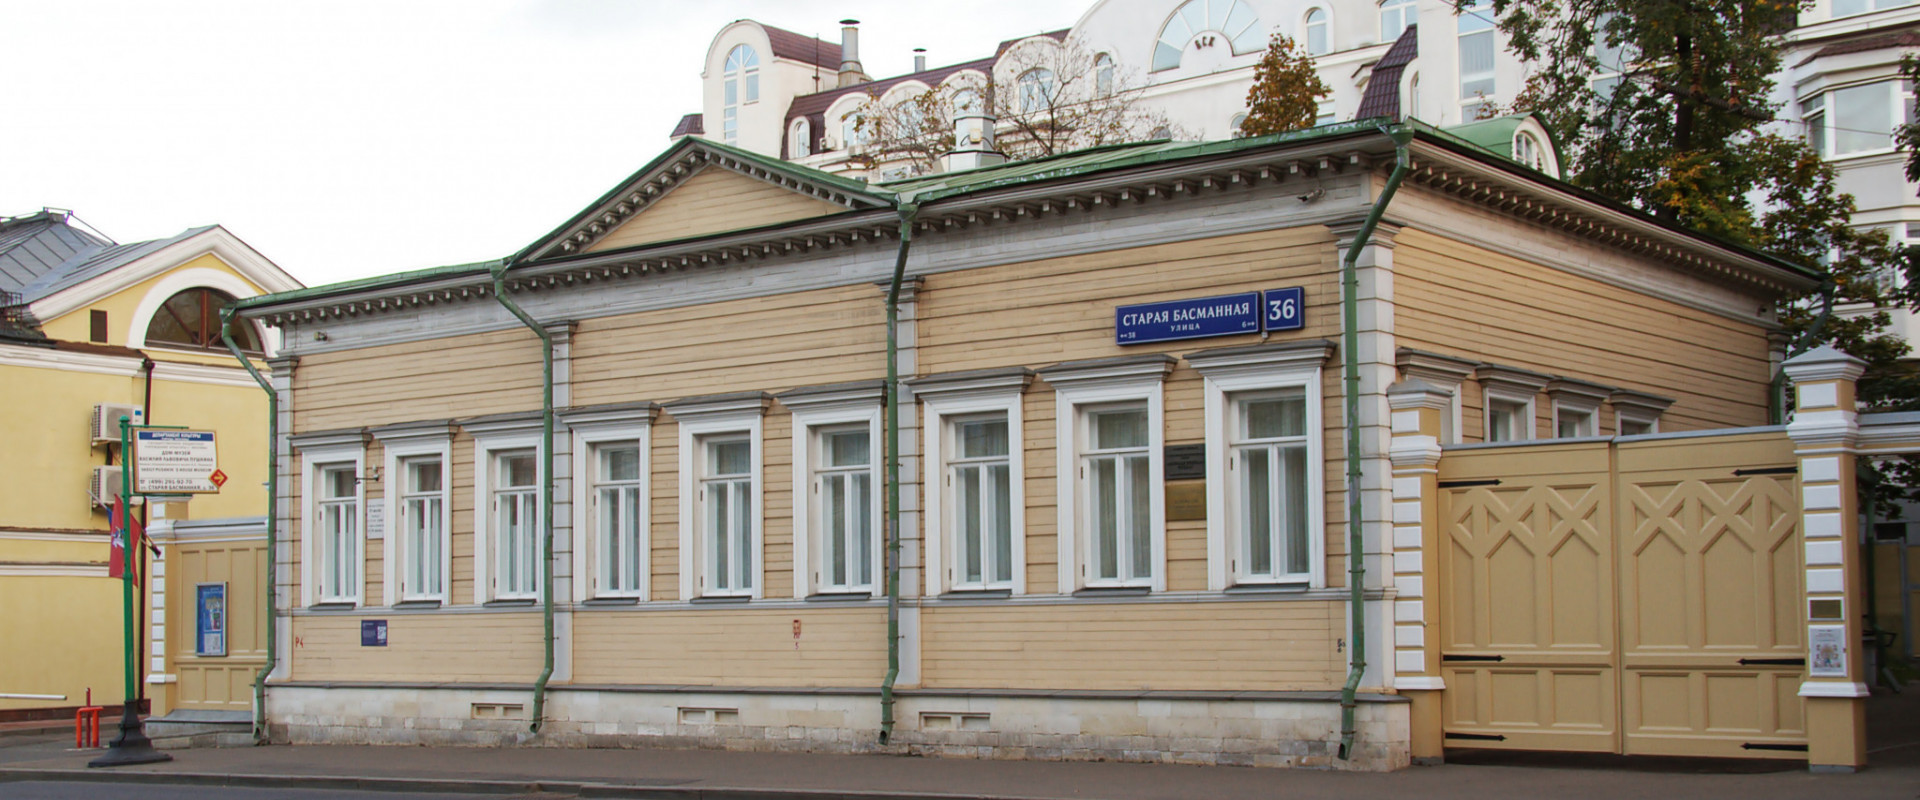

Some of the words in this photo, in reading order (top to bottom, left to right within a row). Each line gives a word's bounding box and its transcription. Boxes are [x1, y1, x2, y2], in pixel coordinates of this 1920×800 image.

[1122, 310, 1169, 327] СТАРАЯ
[1173, 302, 1250, 322] БАСМАННАЯ
[1268, 299, 1296, 321] 36
[1170, 323, 1201, 332] УЛИЦА
